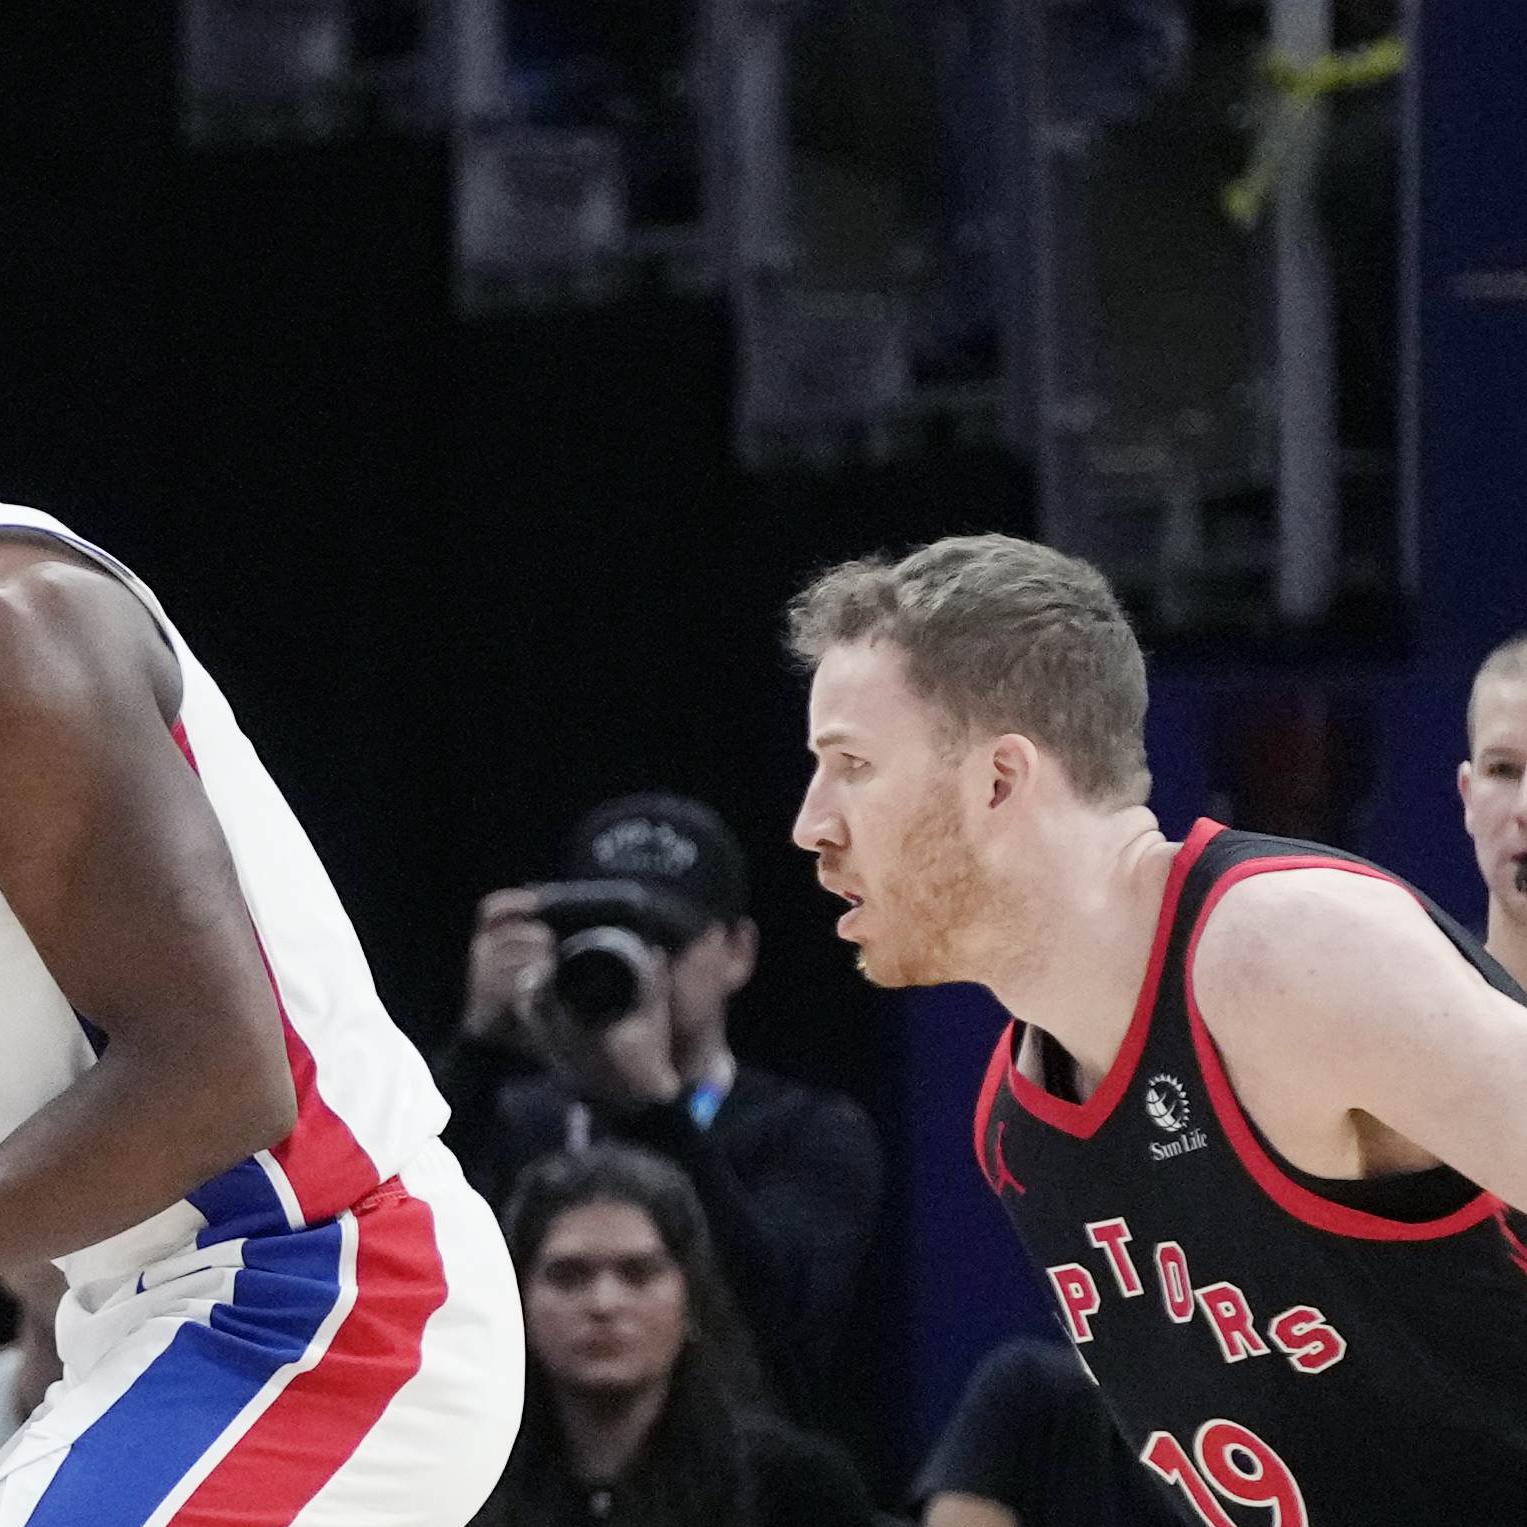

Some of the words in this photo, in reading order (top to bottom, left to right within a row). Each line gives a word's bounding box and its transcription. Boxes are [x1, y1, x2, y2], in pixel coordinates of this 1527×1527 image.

[1148, 1141, 1182, 1161] Sun
[1180, 1127, 1208, 1152] Life
[1046, 1216, 1347, 1386] PTORS
